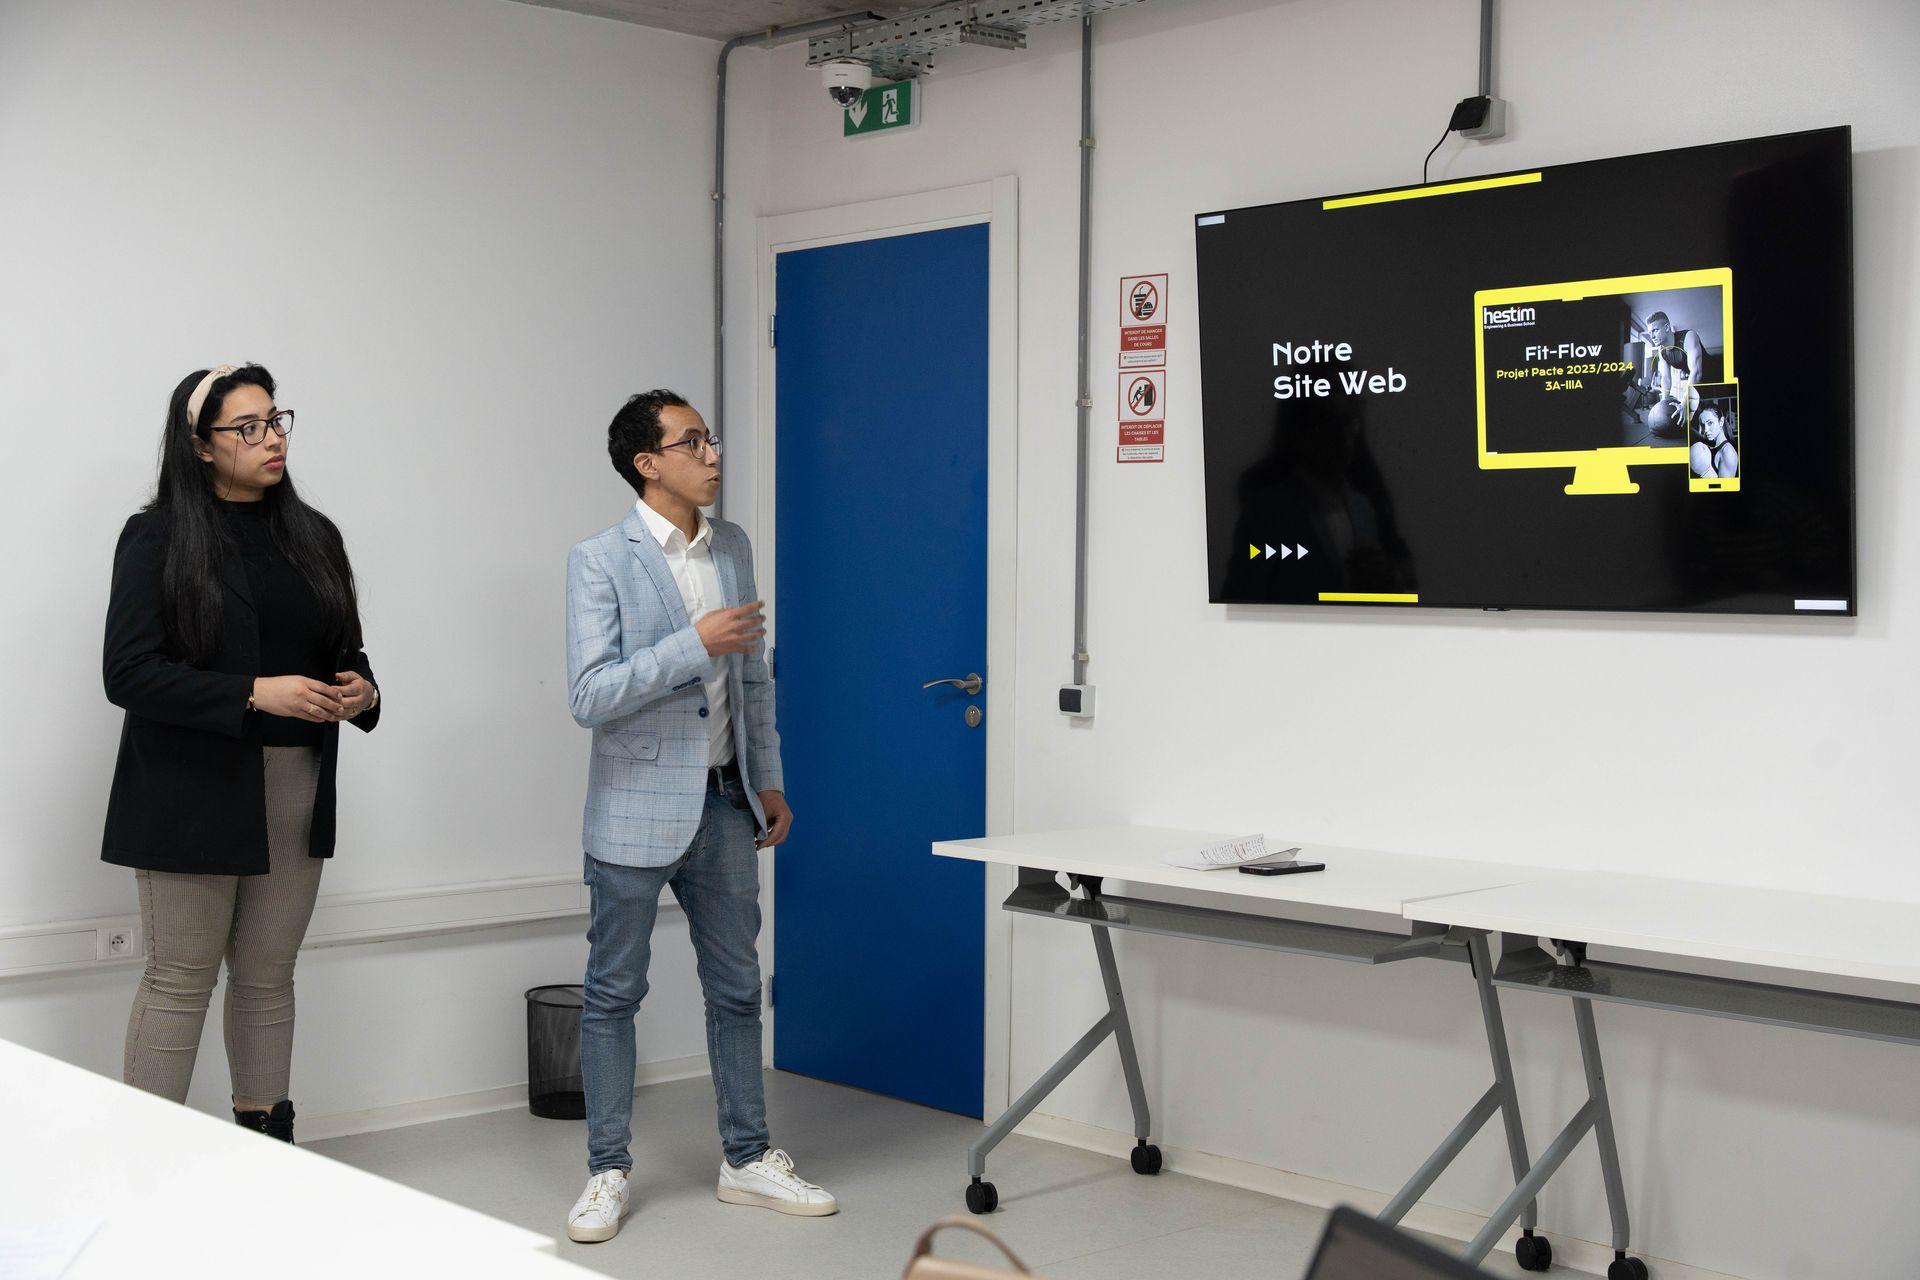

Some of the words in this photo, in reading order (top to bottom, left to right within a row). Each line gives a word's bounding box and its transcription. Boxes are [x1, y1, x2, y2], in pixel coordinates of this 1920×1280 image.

[1483, 306, 1536, 325] hestim
[1272, 340, 1353, 366] Notre
[1525, 343, 1603, 361] Fit-Flow
[1496, 368, 1529, 380] Projet
[1531, 366, 1564, 377] Pacte
[1566, 361, 1634, 375] 2023/2024
[1273, 373, 1331, 400] Site
[1338, 367, 1407, 396] Web
